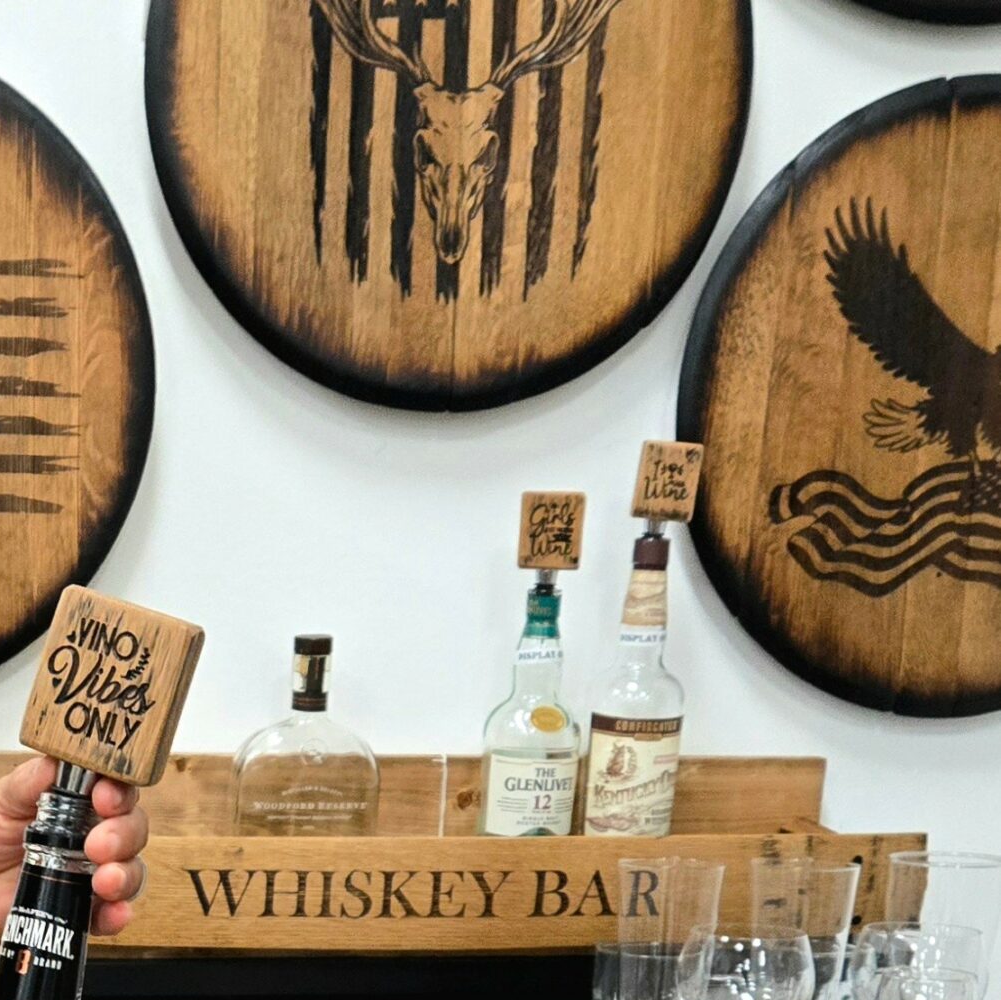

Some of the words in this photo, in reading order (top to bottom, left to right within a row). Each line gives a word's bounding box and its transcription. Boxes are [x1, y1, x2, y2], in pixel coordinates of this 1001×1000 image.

[77, 617, 139, 661] VINO
[48, 644, 156, 716] Vibes
[63, 701, 142, 750] ONLY
[535, 766, 555, 778] THE
[533, 793, 552, 810] 12
[183, 867, 514, 919] WHISKEY
[527, 868, 659, 919] BAR
[2, 913, 75, 960] ENCHMARK
